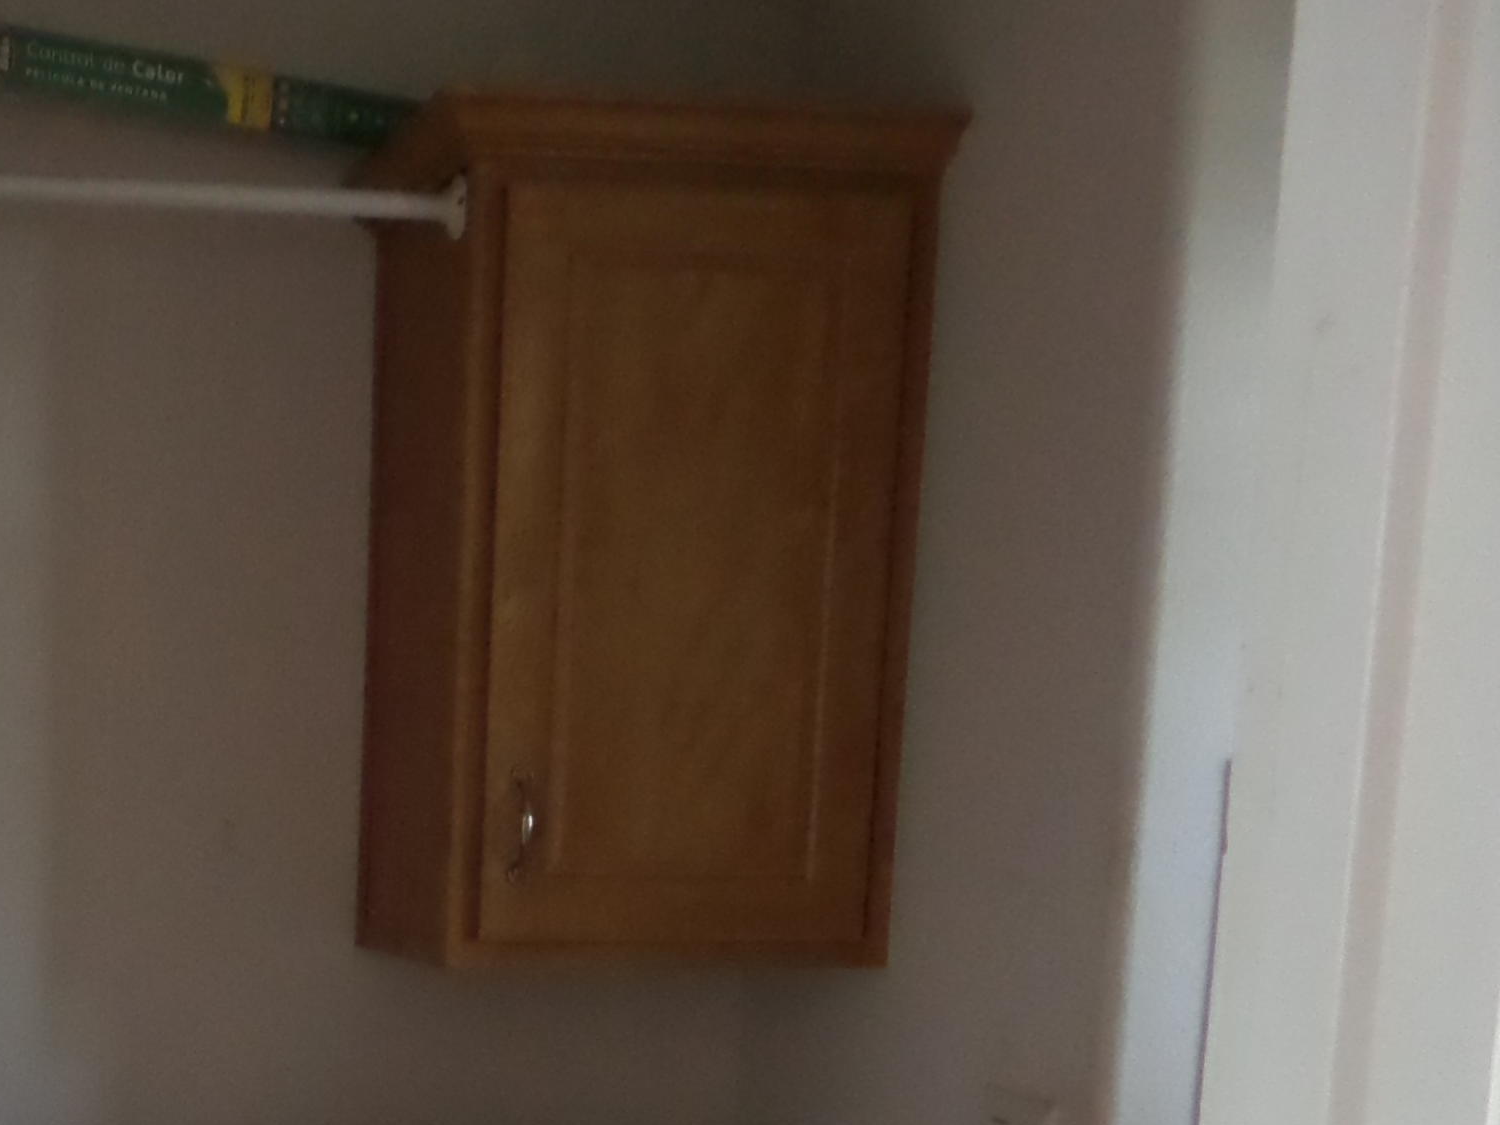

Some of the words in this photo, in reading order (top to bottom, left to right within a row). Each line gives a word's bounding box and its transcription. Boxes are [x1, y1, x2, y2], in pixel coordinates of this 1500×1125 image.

[27, 41, 94, 68] Control
[102, 56, 125, 73] de
[132, 59, 184, 84] Calor
